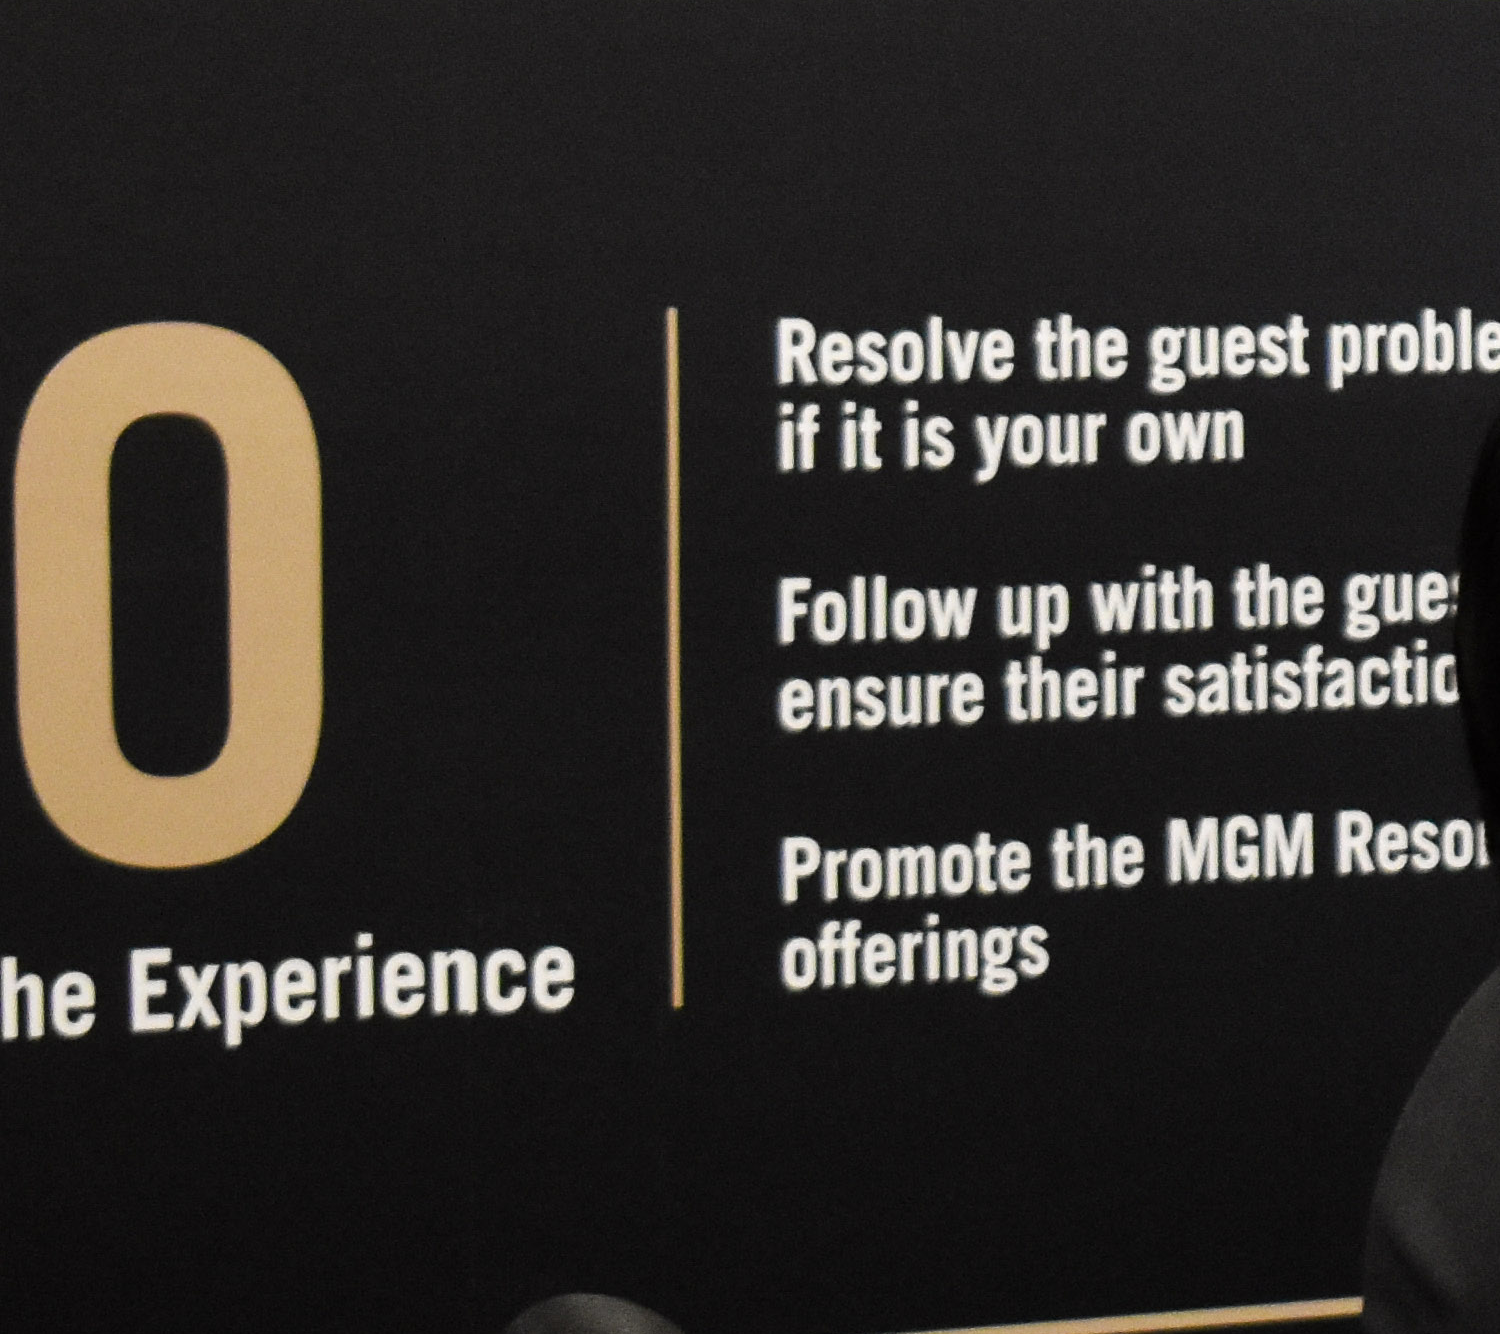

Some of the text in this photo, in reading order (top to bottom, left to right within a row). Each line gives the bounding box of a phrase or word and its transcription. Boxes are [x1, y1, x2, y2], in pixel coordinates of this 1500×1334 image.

[775, 314, 1015, 386] Resolve
[1032, 312, 1129, 382] the
[1147, 313, 1311, 395] guest
[777, 398, 1245, 485] if it is your own
[777, 574, 978, 646] Follow
[996, 583, 1070, 653] up
[1089, 563, 1214, 634] with
[1231, 562, 1325, 630] the
[777, 671, 985, 733] ensure
[1002, 649, 1146, 724] their
[780, 831, 1032, 905] Promote
[1050, 822, 1145, 891] the
[1165, 811, 1314, 884] MGM
[1, 931, 576, 1049] he Experience
[780, 912, 1050, 996] offerings
